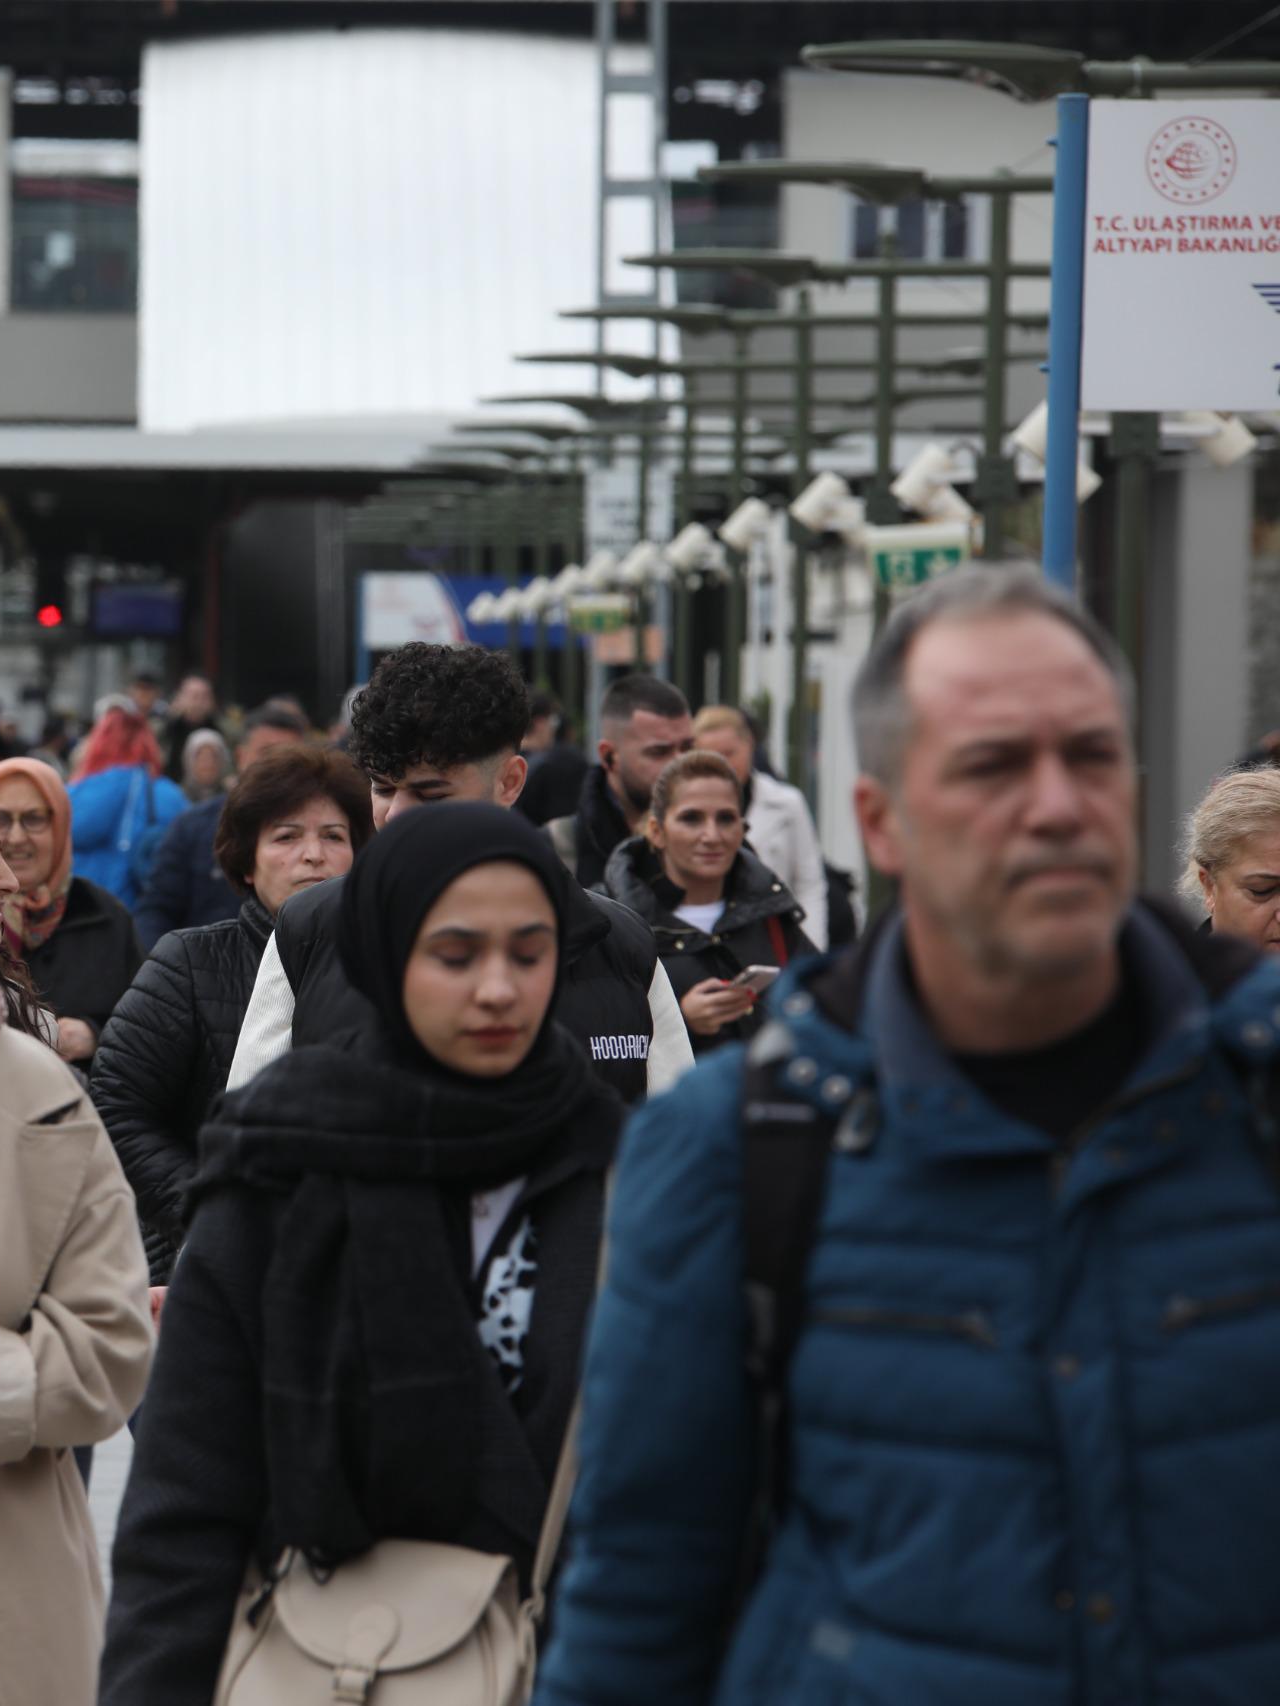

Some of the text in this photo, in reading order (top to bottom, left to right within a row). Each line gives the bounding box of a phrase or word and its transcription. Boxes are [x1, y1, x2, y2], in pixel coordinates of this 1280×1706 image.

[1094, 214, 1128, 231] T.C.
[1133, 214, 1253, 234] ULAŞTIRMA
[1094, 233, 1280, 253] ALTYAPI BAKANLIĞ
